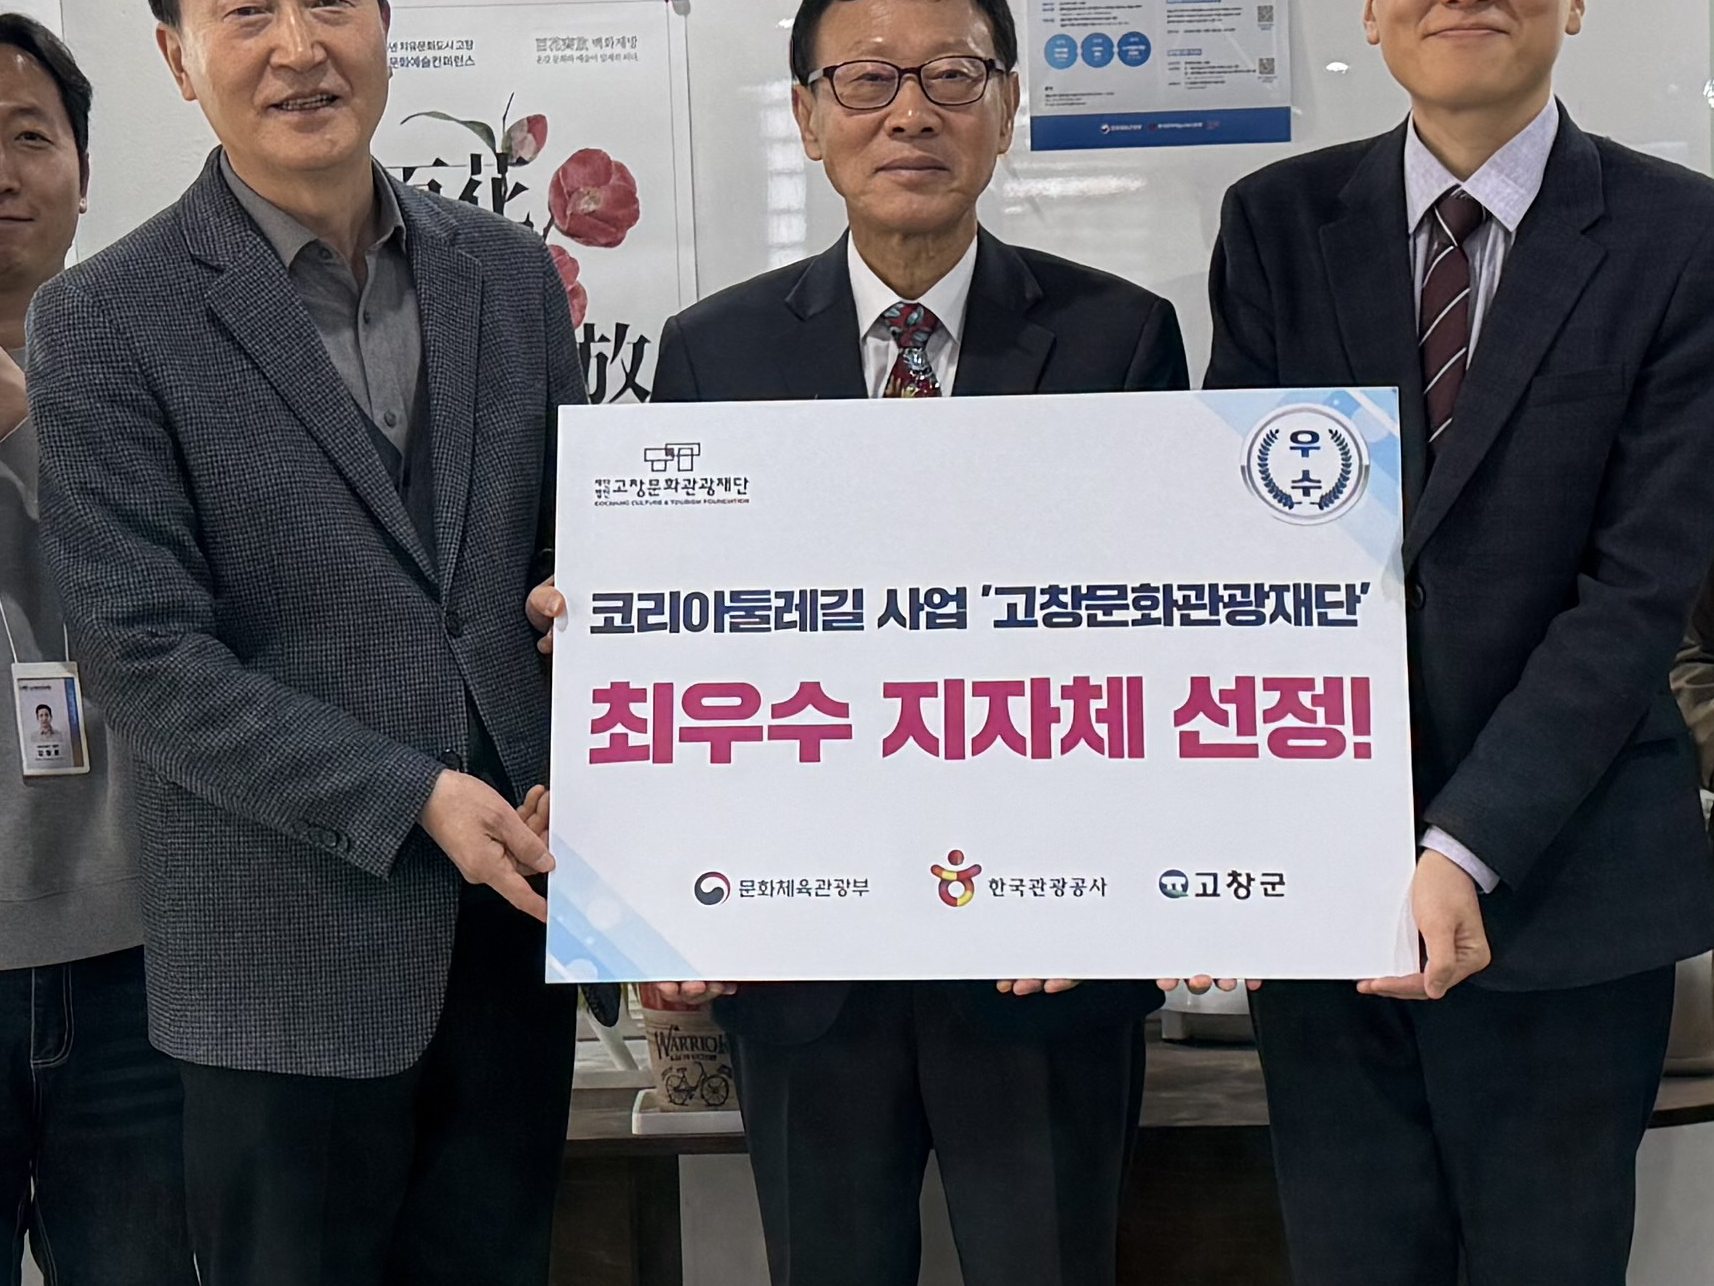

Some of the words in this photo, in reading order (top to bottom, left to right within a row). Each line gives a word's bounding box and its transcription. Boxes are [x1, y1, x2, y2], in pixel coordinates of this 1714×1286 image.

[612, 476, 749, 498] 고창문화관광재단
[589, 588, 865, 634] 코리아둘레길
[877, 586, 968, 631] 사업
[589, 681, 853, 765] 최우수
[882, 675, 1145, 761] 지자체
[1173, 675, 1373, 760] 선정!
[738, 877, 871, 899] 문화체육관광부
[987, 876, 1108, 898] 한국관광공사
[1193, 869, 1286, 901] 고창군
